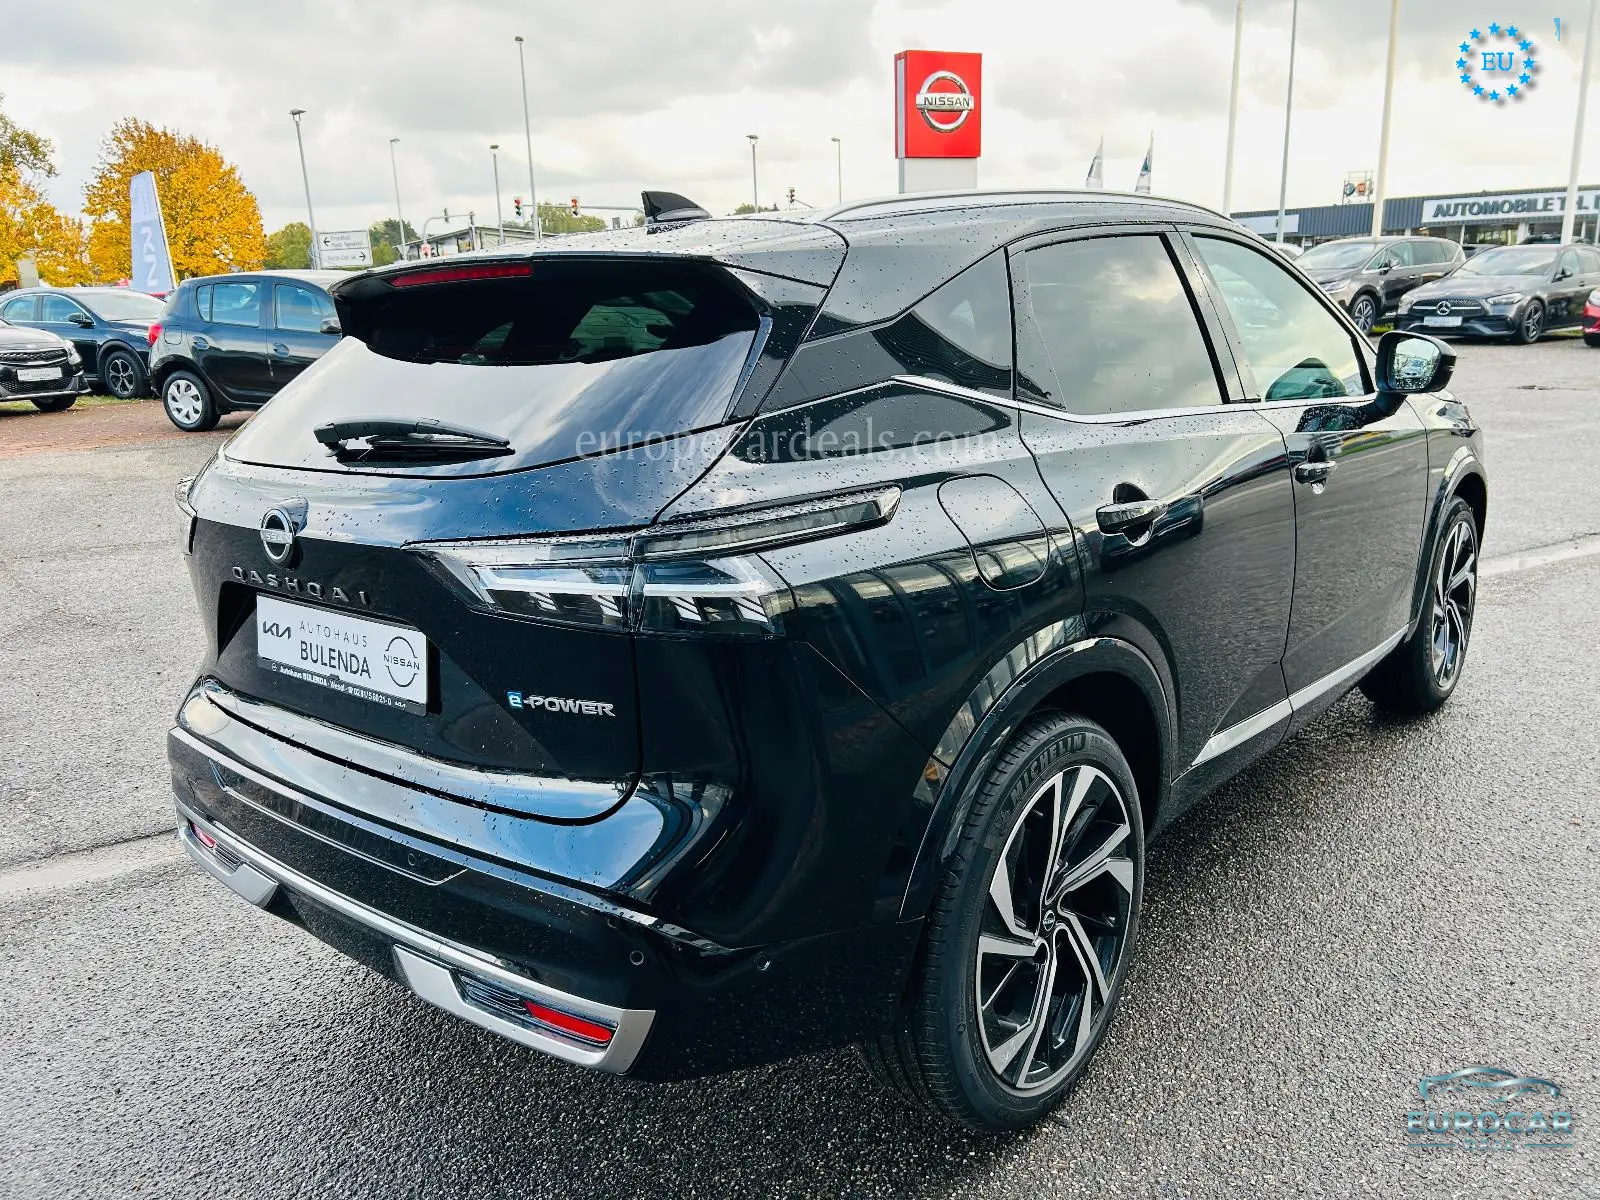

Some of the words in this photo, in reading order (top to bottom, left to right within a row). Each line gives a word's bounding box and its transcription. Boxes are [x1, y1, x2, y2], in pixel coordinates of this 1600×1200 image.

[923, 96, 970, 107] NISSAN
[1433, 197, 1554, 217] AUTOMOBILE
[232, 566, 367, 605] QASHQAI
[299, 620, 368, 648] AUTOHAUS
[300, 640, 372, 679] BULENDA
[383, 653, 420, 670] NISSAN
[1010, 732, 1087, 807] MICHELIN
